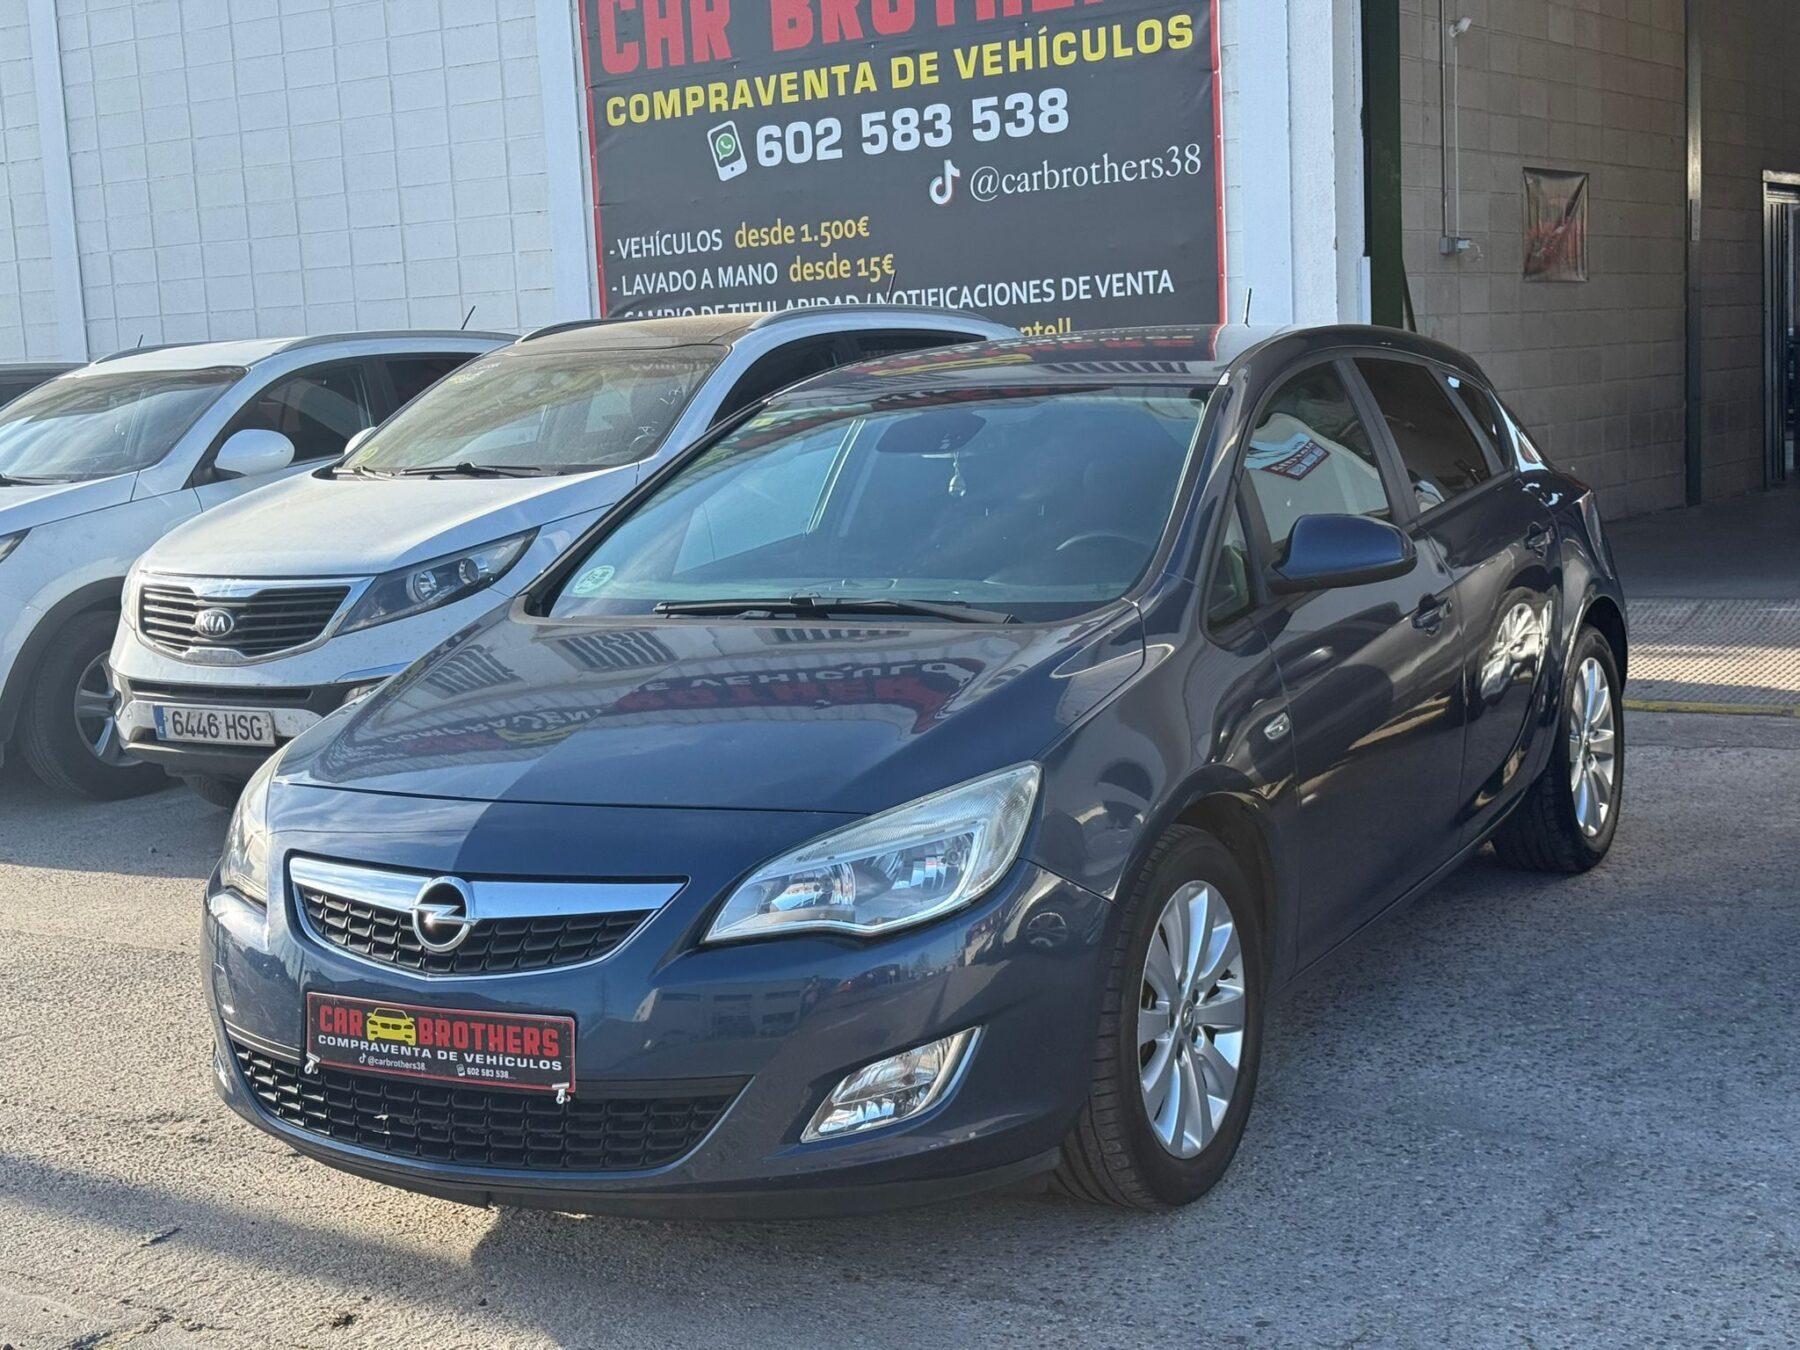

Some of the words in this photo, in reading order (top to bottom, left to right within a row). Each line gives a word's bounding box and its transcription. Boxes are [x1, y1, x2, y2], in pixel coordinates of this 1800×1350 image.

[606, 62, 877, 126] COMPRAVENTA
[891, 52, 939, 89] DE
[954, 14, 1193, 79] VEHÍCULOS
[756, 117, 843, 167] 602
[861, 103, 952, 155] 583
[971, 87, 1069, 142] 538
[969, 143, 1202, 201] @carbrothers38
[617, 229, 723, 259] VEHÍCULOS
[735, 219, 795, 249] desde
[801, 216, 870, 247] 1.500€
[622, 269, 696, 296] LAVADO
[700, 268, 714, 289] A
[718, 262, 778, 289] MANO
[789, 252, 850, 282] desde
[857, 254, 895, 282] 15€
[1062, 275, 1091, 301] DE
[1095, 269, 1175, 299] VENTA
[200, 616, 226, 631] KIA
[171, 711, 219, 738] 6446
[224, 714, 263, 741] HSG
[318, 1034, 432, 1058] COMPRAVENTA
[437, 1050, 458, 1062] DE
[464, 1052, 562, 1071] VEHÍCULOS
[319, 1005, 363, 1037] CAR
[418, 1017, 559, 1057] BROTHERS
[367, 1055, 425, 1071] @carbrothers38
[481, 1068, 494, 1078] 583
[496, 1069, 509, 1079] 538
